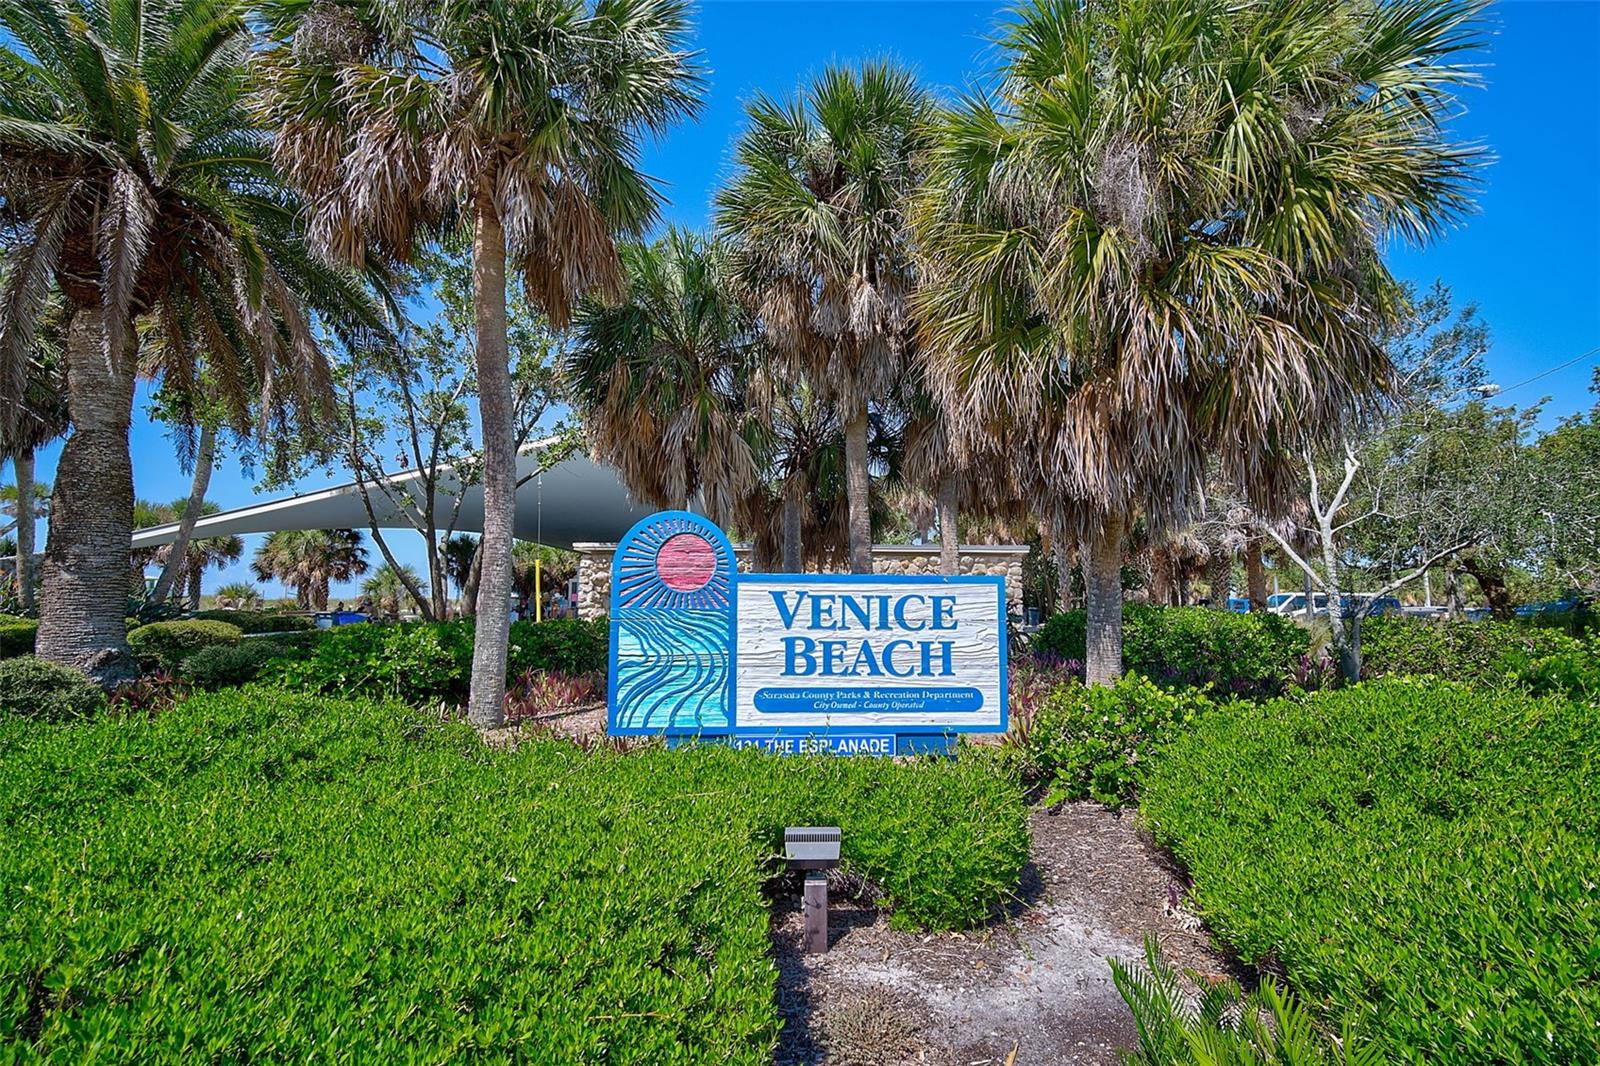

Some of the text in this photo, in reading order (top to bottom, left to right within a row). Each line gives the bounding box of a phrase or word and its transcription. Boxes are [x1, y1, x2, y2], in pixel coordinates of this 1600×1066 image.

[768, 590, 958, 631] VENICE
[780, 636, 956, 677] BEACH
[762, 691, 974, 700] Sarasota County Parks & Recreation Department
[813, 701, 829, 710] City
[831, 701, 857, 709] Owned
[863, 701, 889, 710] County
[891, 701, 925, 710] Operated
[764, 739, 794, 753] THE
[799, 738, 890, 753] ESPLANADE
